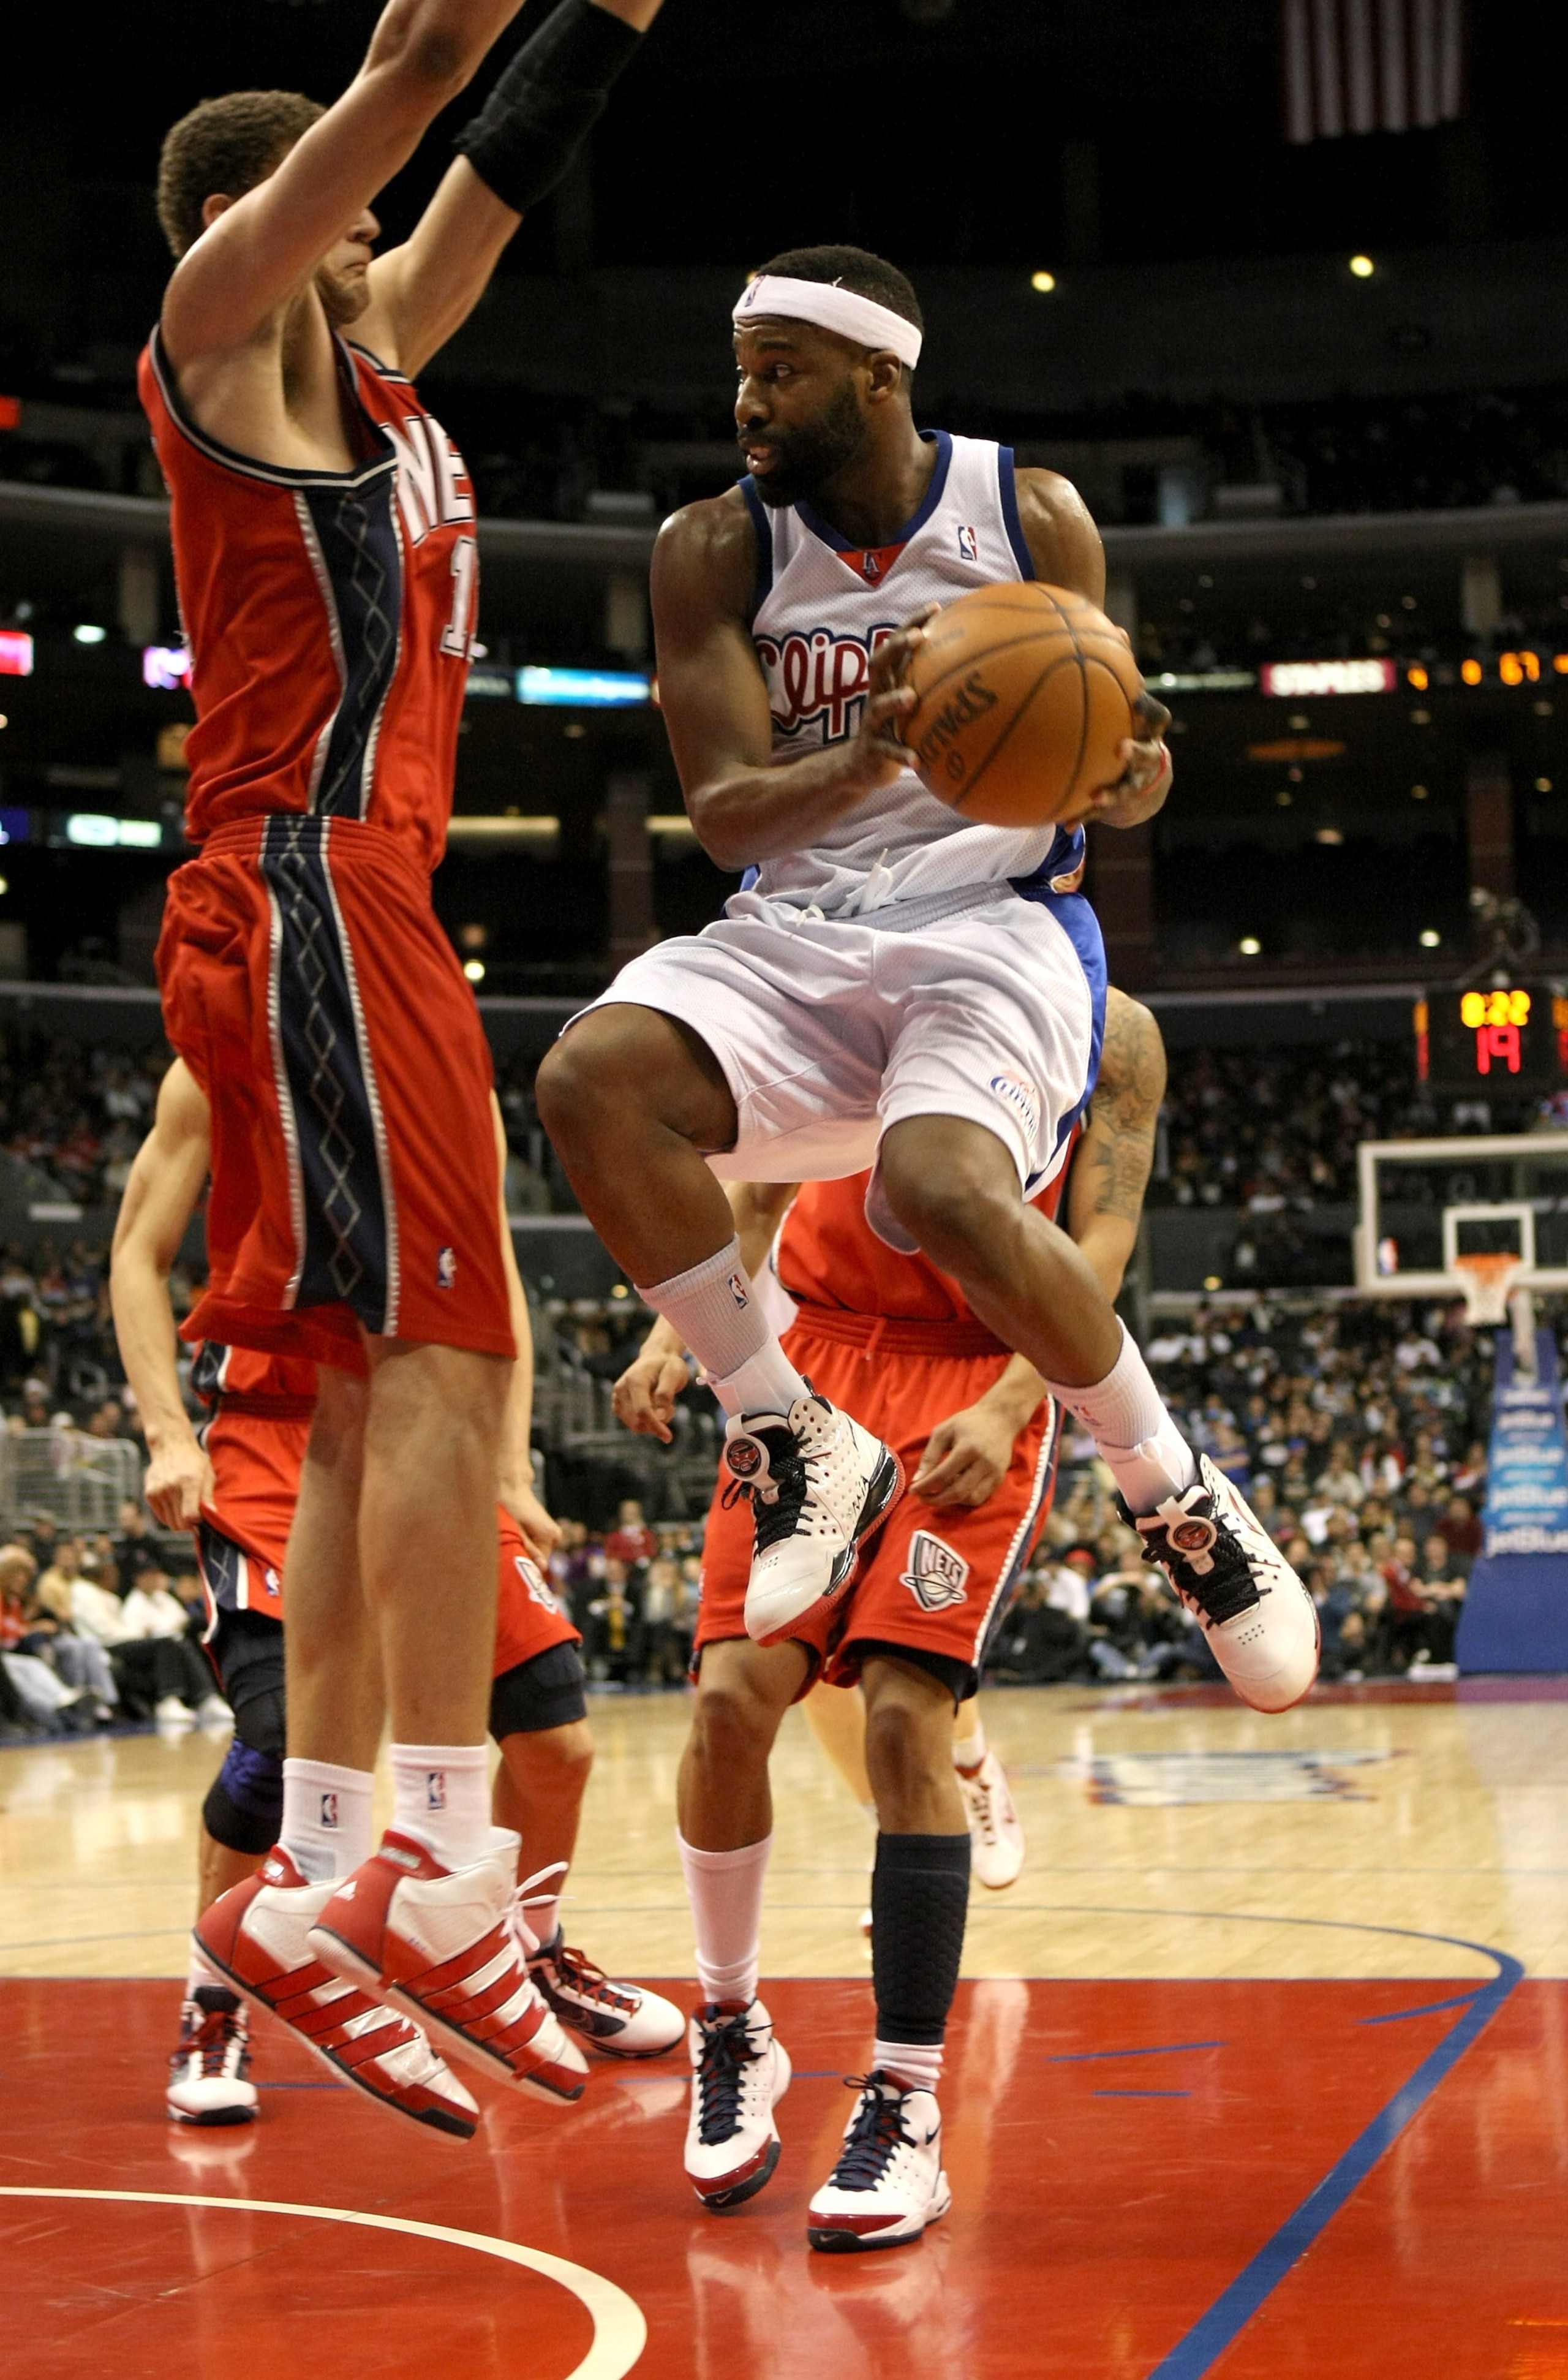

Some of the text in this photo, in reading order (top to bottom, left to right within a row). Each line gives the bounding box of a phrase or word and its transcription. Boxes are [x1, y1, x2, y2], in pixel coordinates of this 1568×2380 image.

[440, 535, 480, 664] 1
[1477, 1024, 1520, 1075] 19
[921, 1539, 963, 1588] NETS
